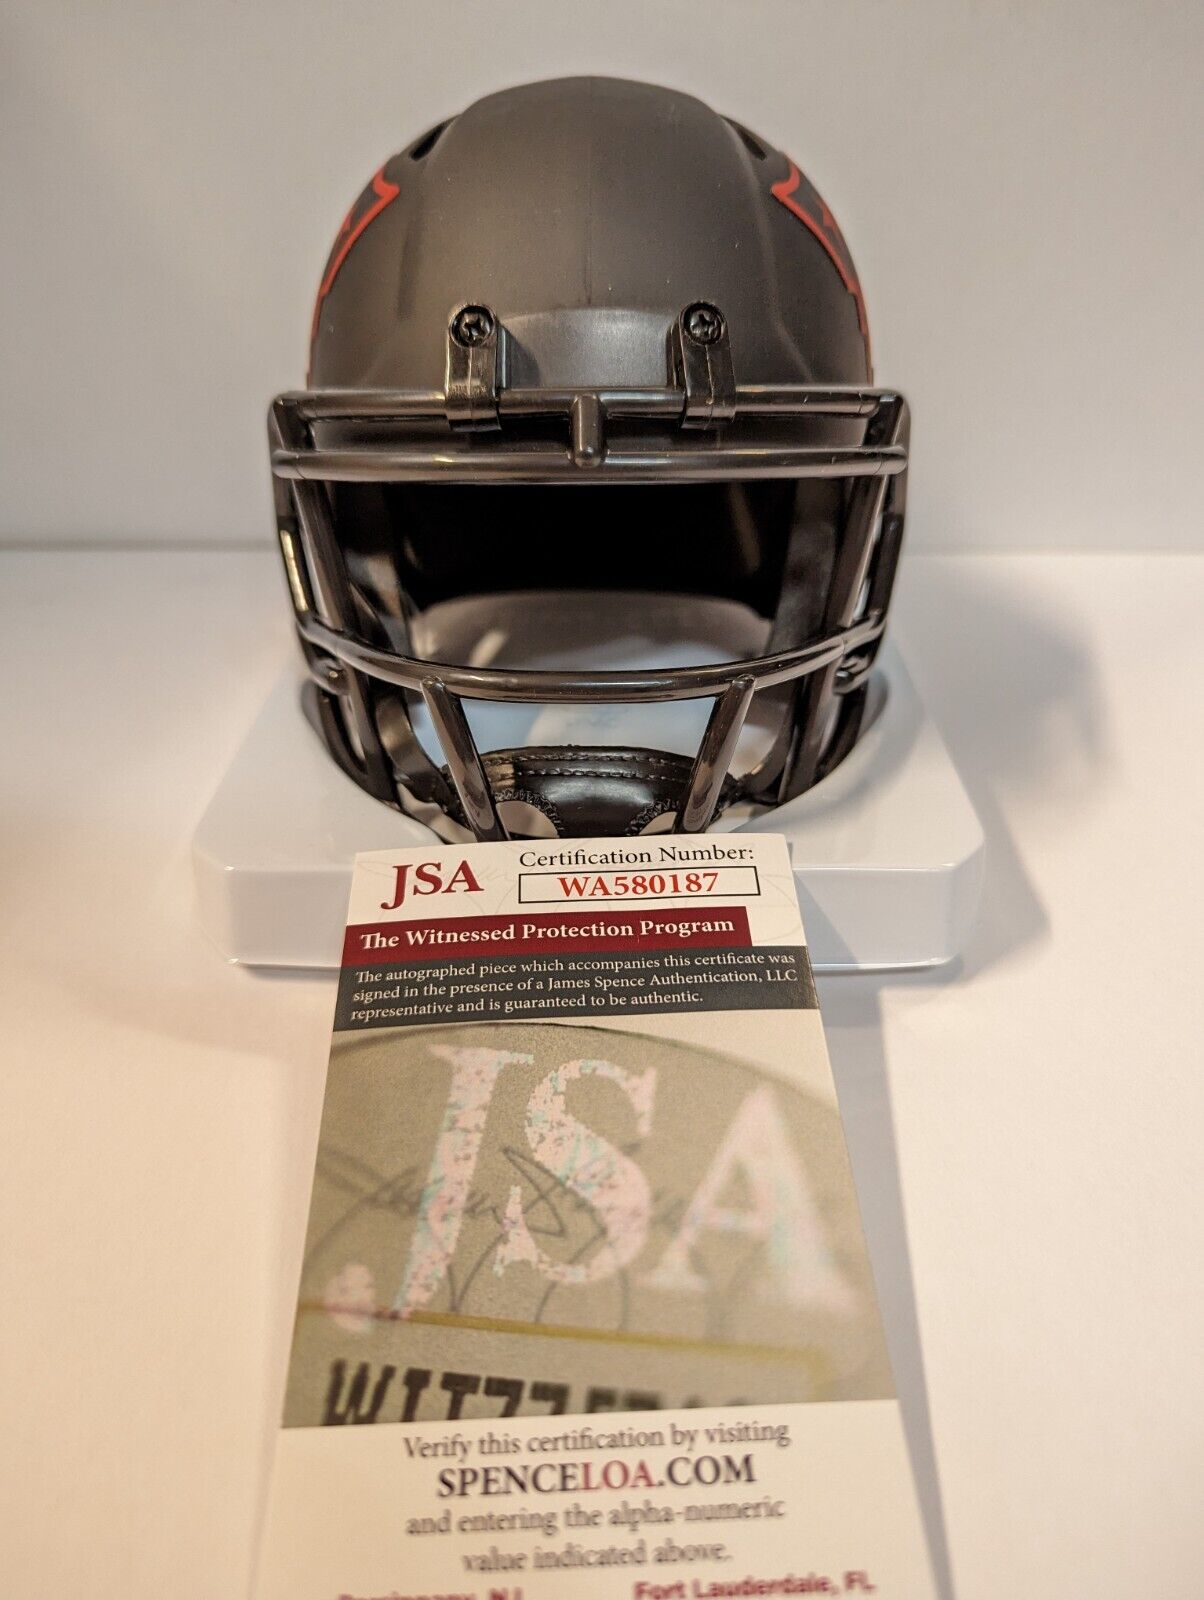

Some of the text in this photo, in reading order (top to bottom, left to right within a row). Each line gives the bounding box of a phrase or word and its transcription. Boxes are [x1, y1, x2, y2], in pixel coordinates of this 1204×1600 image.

[519, 844, 755, 867] Certification Number:
[380, 860, 485, 910] JSA
[557, 872, 719, 897] WA580187
[361, 918, 736, 949] The Witnessed Protection Program
[356, 952, 795, 983] The autographed piece which accompanies this certificate was
[354, 969, 798, 1003] signed in the presence of a James Spence Authentication, LLC
[351, 990, 704, 1022] representative and is guaranteed to be authentic.
[403, 1420, 792, 1463] Verify this certification by visiting
[437, 1454, 757, 1497] SPENCELOA.COM
[406, 1495, 785, 1536] and entering the alpha-numeric
[462, 1537, 733, 1570] value indicated above.
